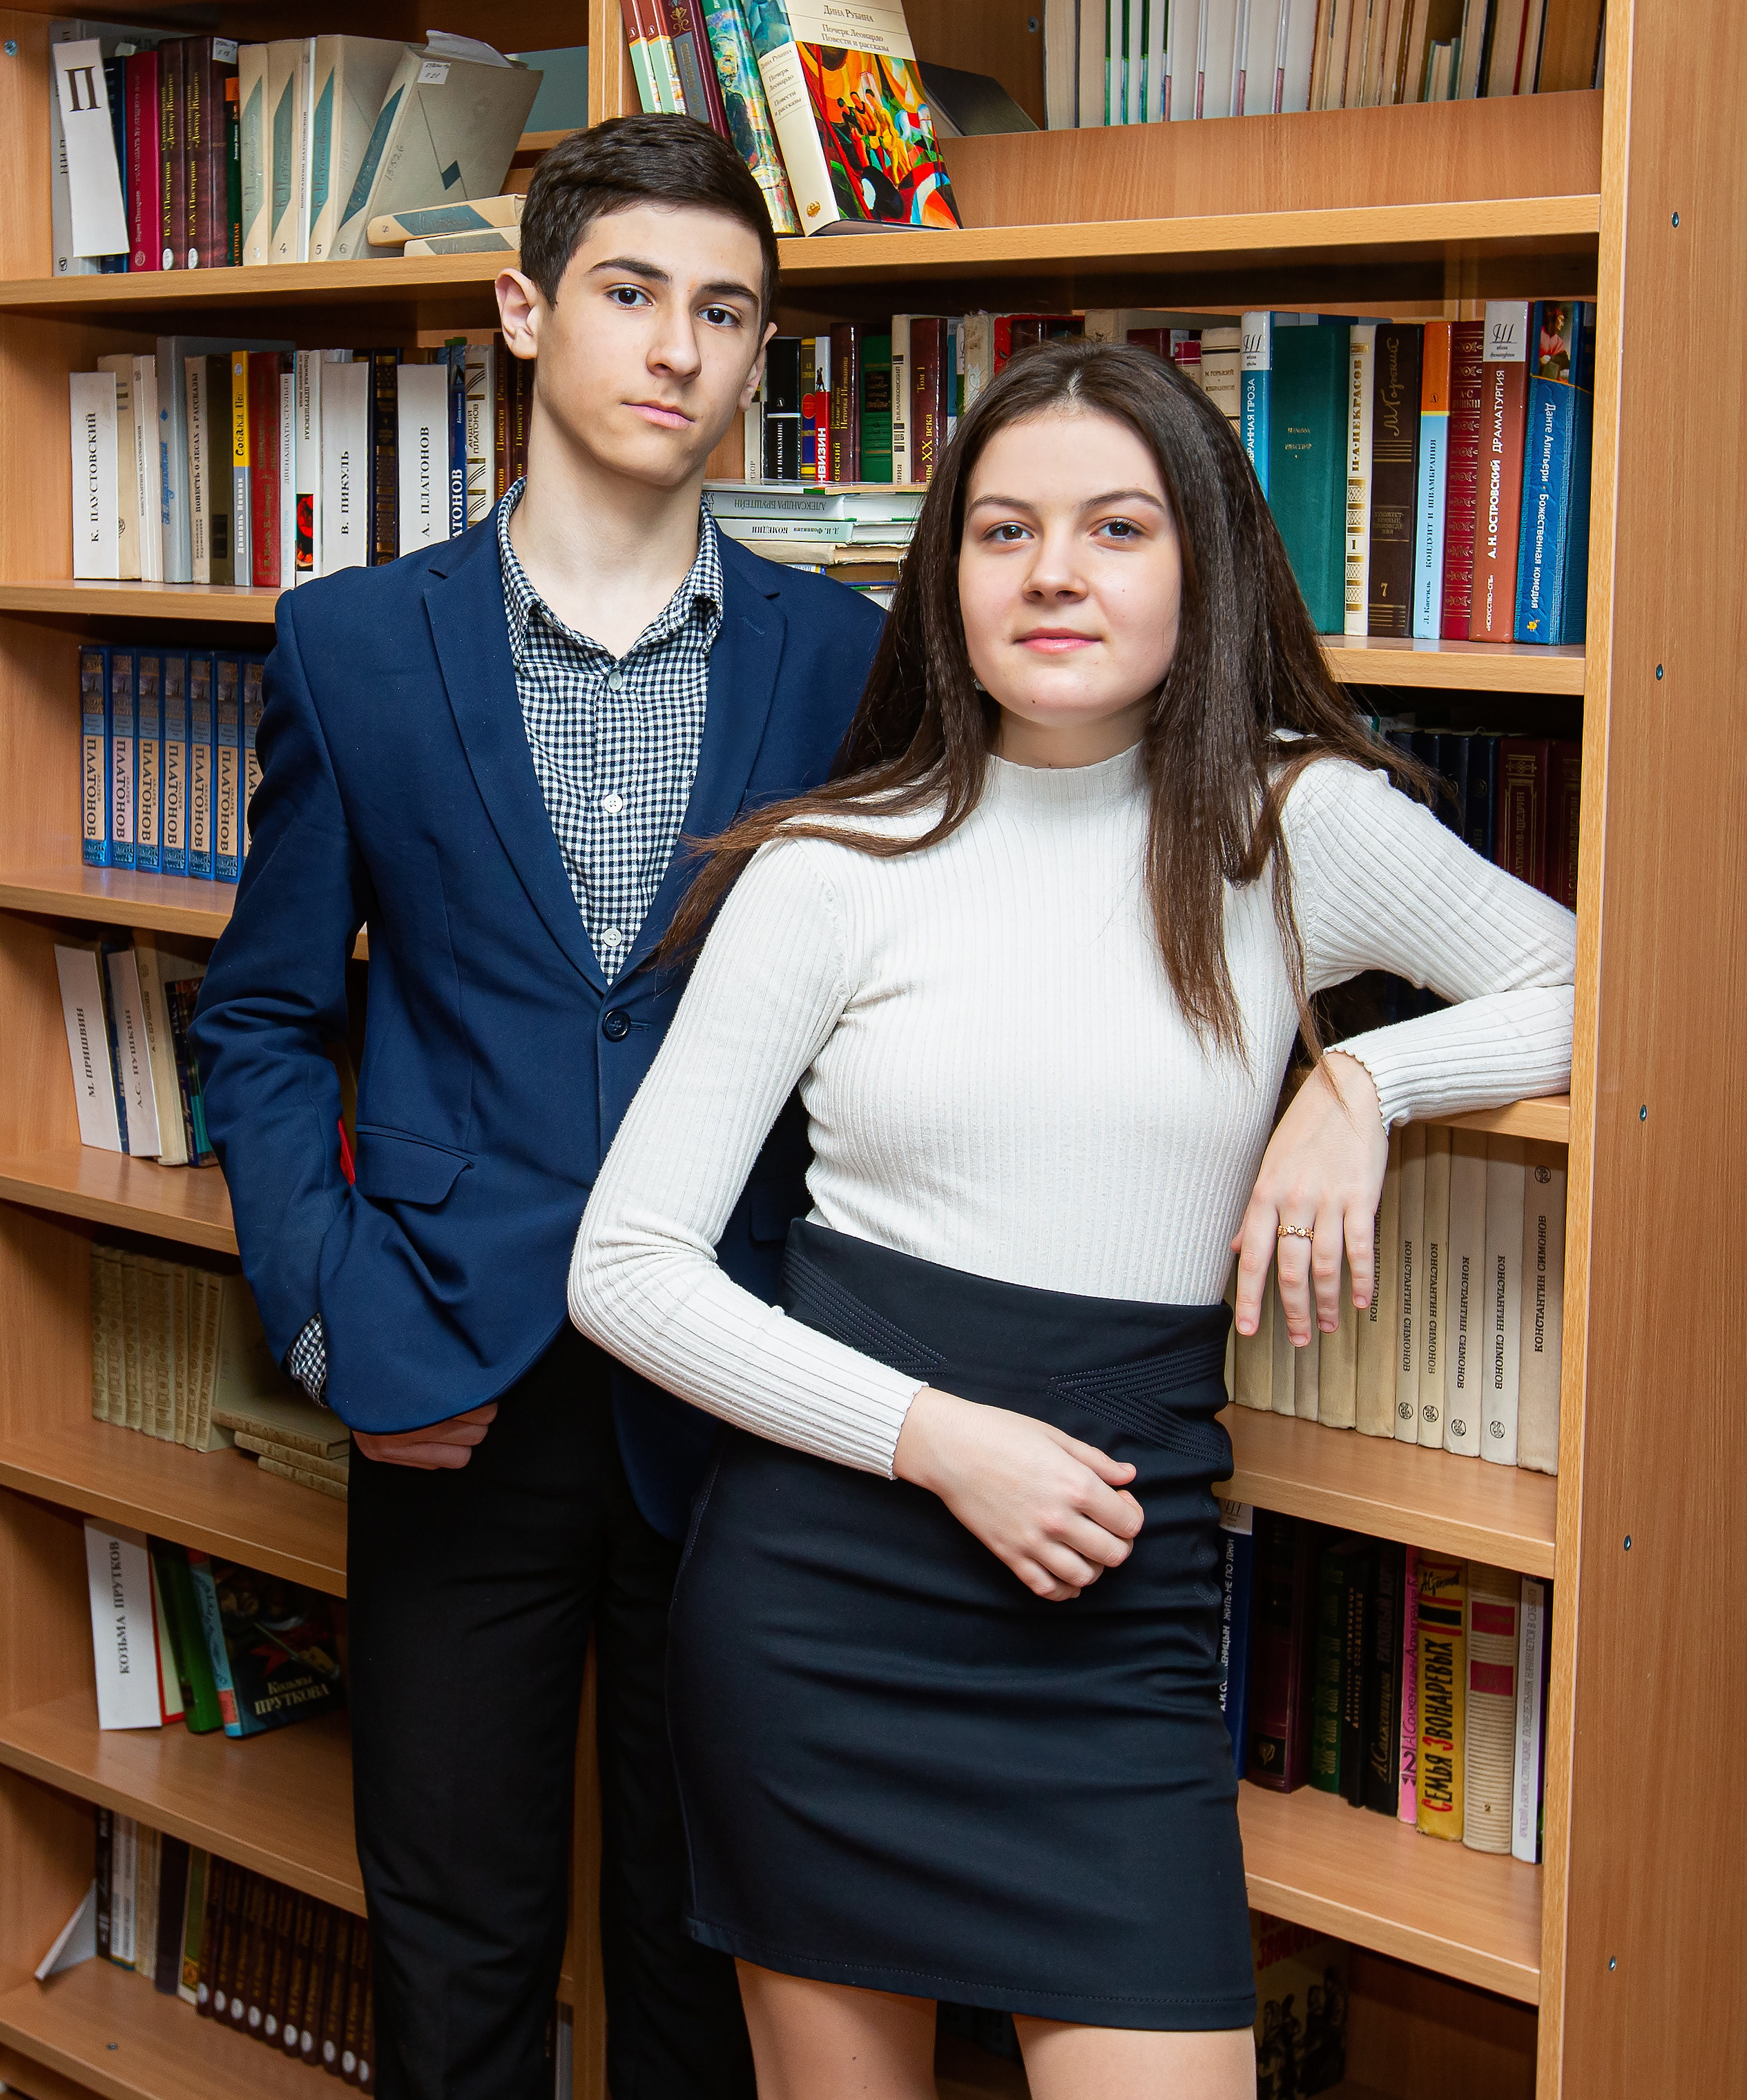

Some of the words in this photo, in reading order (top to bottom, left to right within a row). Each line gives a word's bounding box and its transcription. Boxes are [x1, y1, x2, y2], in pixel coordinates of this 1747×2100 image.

[821, 33, 851, 45] Повести
[858, 41, 890, 52] рассказы
[822, 23, 850, 37] Почерк
[851, 29, 884, 43] Леонардо
[64, 66, 102, 112] П
[769, 68, 789, 82] Почерк
[773, 91, 797, 106] Повести
[163, 162, 173, 210] Пастернак
[189, 160, 198, 209] Пастернак
[279, 242, 287, 254] 4
[315, 244, 322, 254] 5
[339, 243, 347, 254] 6
[840, 356, 849, 396] Незванова
[916, 374, 925, 393] Том
[1210, 368, 1235, 377] ГОРЬКИЙ
[1380, 337, 1405, 406] Горький
[191, 372, 200, 421] РАССКАЗЫ
[840, 398, 849, 430] Неточка
[1247, 378, 1256, 412] ПРОЗА
[1492, 370, 1505, 453] ДРАМАТУРГИЯ
[496, 409, 505, 451] Повести
[515, 404, 523, 446] Повести
[925, 414, 933, 437] века
[1544, 403, 1556, 434] Данте
[84, 412, 99, 522] ПАУСТОВСКИЙ
[193, 432, 201, 463] ЛЕСАХ
[283, 422, 291, 485] ДВЕНАДЦАТЬ
[1540, 434, 1555, 483] Алигьери
[193, 472, 202, 512] ПОВЕСТЬ
[340, 450, 349, 514] ПИКУЛЬ
[419, 426, 430, 515] ПЛАТОНОВ
[1427, 439, 1436, 508] ШВАМБРАНИЯ
[734, 499, 776, 512] БРУШТЕЙН
[778, 499, 827, 510] АЛЕКСАНДРА
[1487, 459, 1502, 532] ОСТРОВСКИЙ
[90, 529, 99, 542] К.
[340, 521, 349, 535] В.
[421, 523, 430, 538] А.
[751, 526, 789, 534] КОМЕДИИ
[793, 526, 823, 534] Фонвизин
[1425, 522, 1436, 568] КОНДУИТ
[1488, 534, 1498, 546] Н.
[1532, 494, 1549, 565] Божественная
[1487, 547, 1497, 559] А.
[1381, 582, 1388, 597] 7
[1423, 581, 1432, 613] Кассиль
[1529, 566, 1543, 609] комедия
[1423, 615, 1431, 624] Л.
[86, 738, 96, 836] ПЛАТОНОВ
[115, 740, 126, 838] ПЛАТОНОВ
[142, 742, 153, 841] ПЛАТОНОВ
[168, 744, 178, 844] ПЛАТОНОВ
[194, 746, 204, 847] ПЛАТОНОВ
[220, 750, 231, 851] ПЛАТОНОВ
[144, 990, 155, 1034] ПУШКИН
[75, 1006, 93, 1079] ПРИШВИН
[124, 1009, 139, 1075] ПУШКИН
[88, 1083, 96, 1098] М.
[1537, 1215, 1547, 1272] СИМОНОВ
[1404, 1240, 1412, 1315] КОНСТАНТИН
[1429, 1242, 1438, 1318] КОНСТАНТИН
[1460, 1255, 1470, 1332] КОНСТАНТИН
[1496, 1255, 1506, 1331] КОНСТАНТИН
[1534, 1274, 1545, 1353] КОНСТАНТИН
[1402, 1318, 1411, 1372] СИМОНОВ
[1427, 1320, 1437, 1375] СИМОНОВ
[1456, 1334, 1467, 1389] СИМОНОВ
[1494, 1334, 1505, 1389] СИМОНОВ
[1224, 1539, 1235, 1562] ЛЖИ
[1224, 1563, 1233, 1579] ПО
[108, 1541, 125, 1608] ПРУТКОВ
[1224, 1580, 1233, 1593] НЕ
[1224, 1595, 1232, 1621] ЖИТЬ
[118, 1615, 131, 1675] КОЗЬМА
[1376, 1597, 1393, 1663] РАКОВЫЙ
[254, 1682, 331, 1716] ПРУТКОВА
